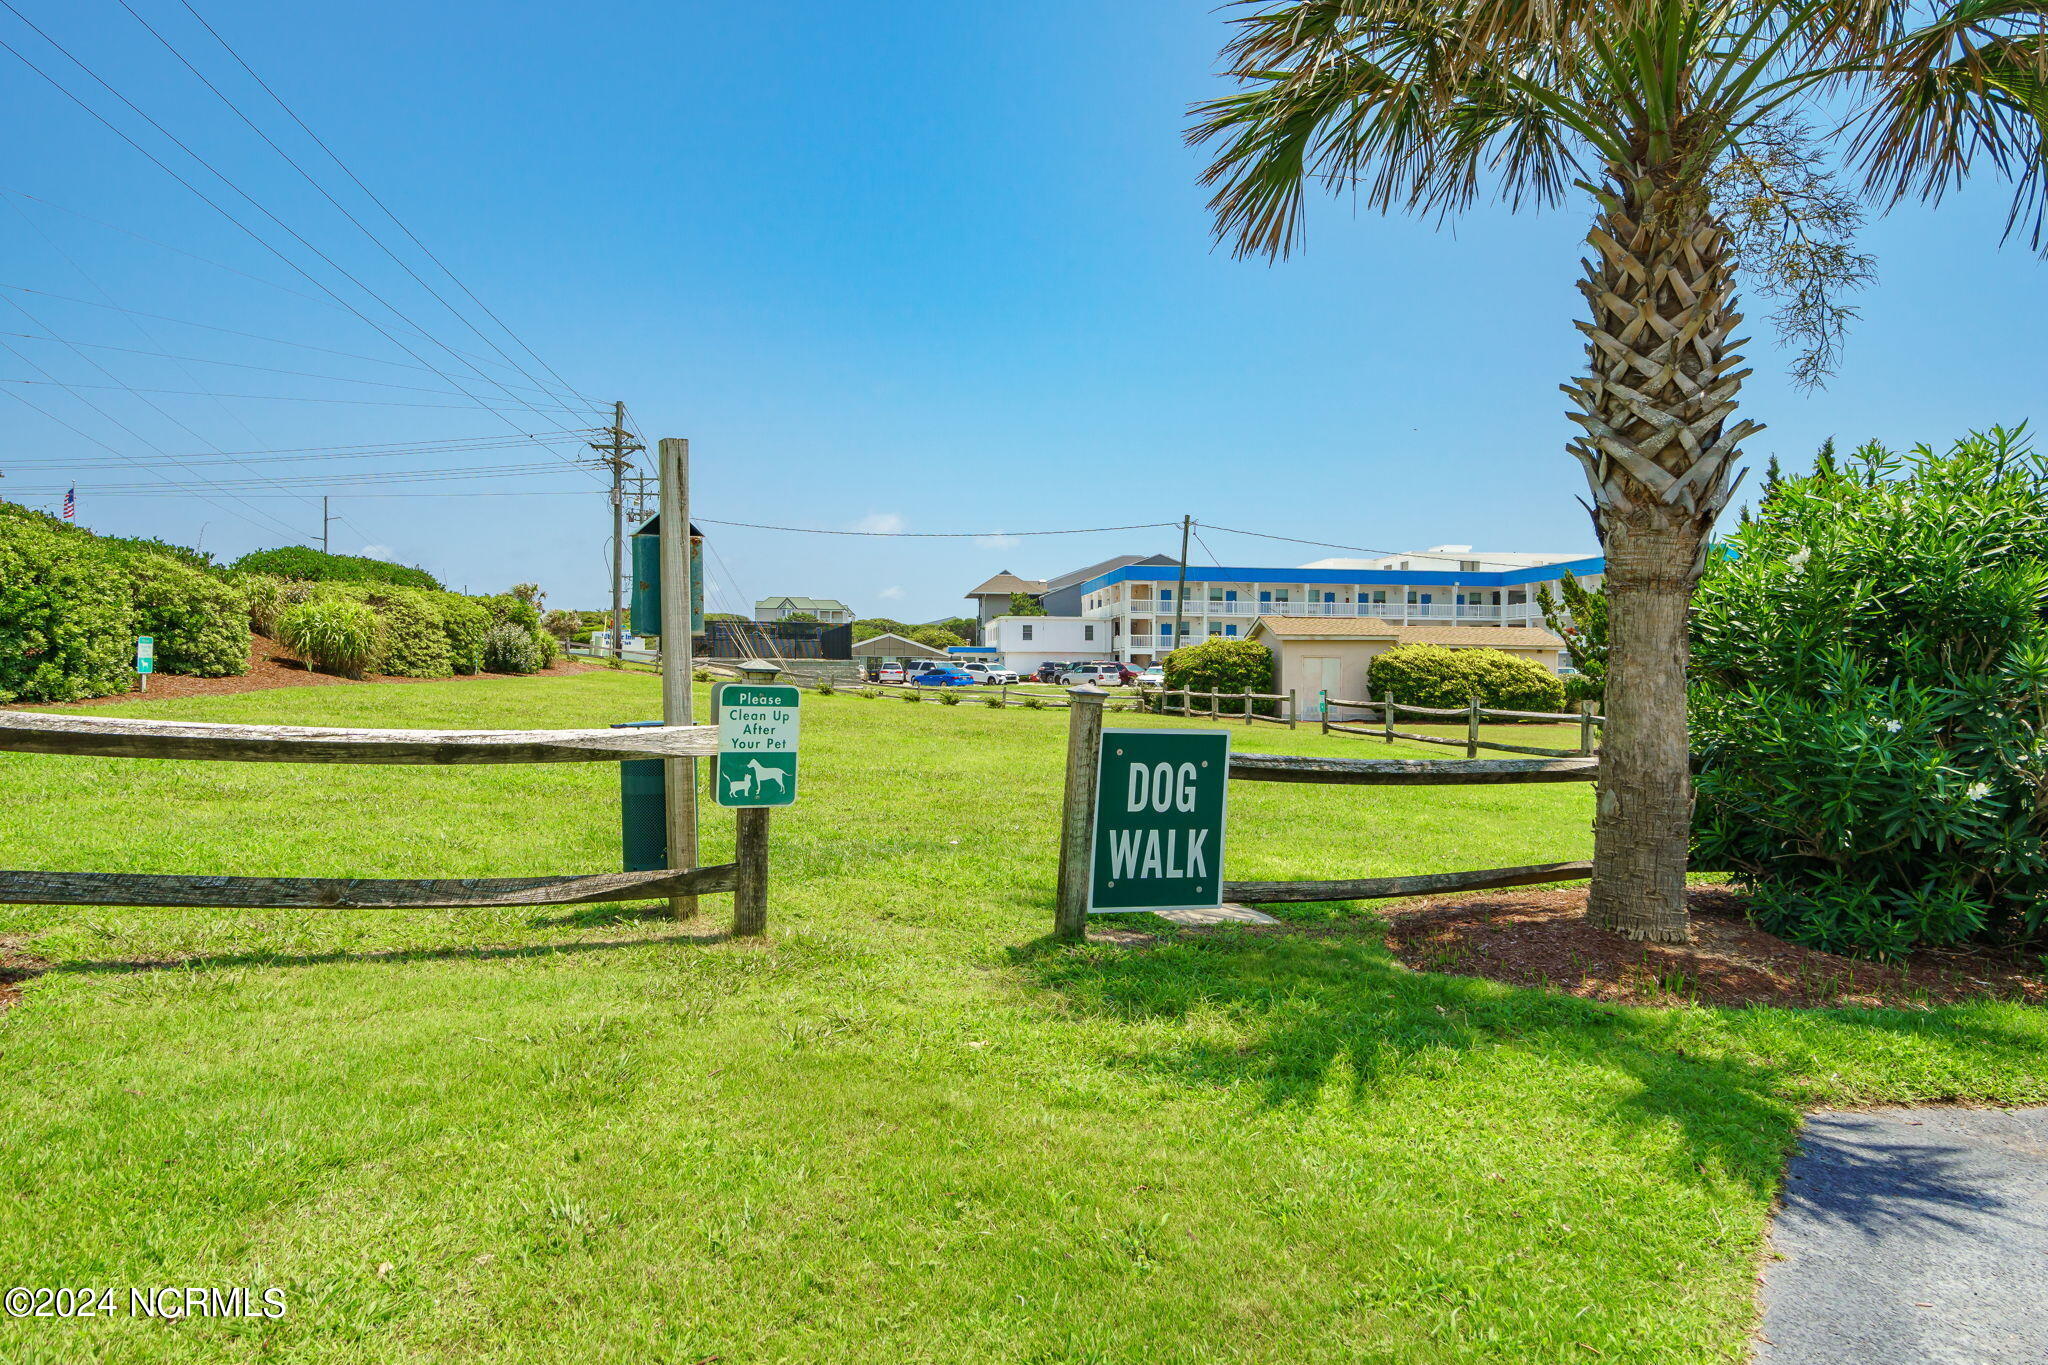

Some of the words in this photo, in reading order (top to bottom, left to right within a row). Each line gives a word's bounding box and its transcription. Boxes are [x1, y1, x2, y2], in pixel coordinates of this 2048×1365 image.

[739, 692, 782, 705] Please
[729, 709, 766, 721] Clean
[773, 710, 790, 724] Up
[743, 723, 776, 735] After
[732, 738, 761, 749] Your
[767, 738, 787, 749] Pet
[1127, 762, 1197, 813] DOG
[1109, 829, 1209, 880] WALK
